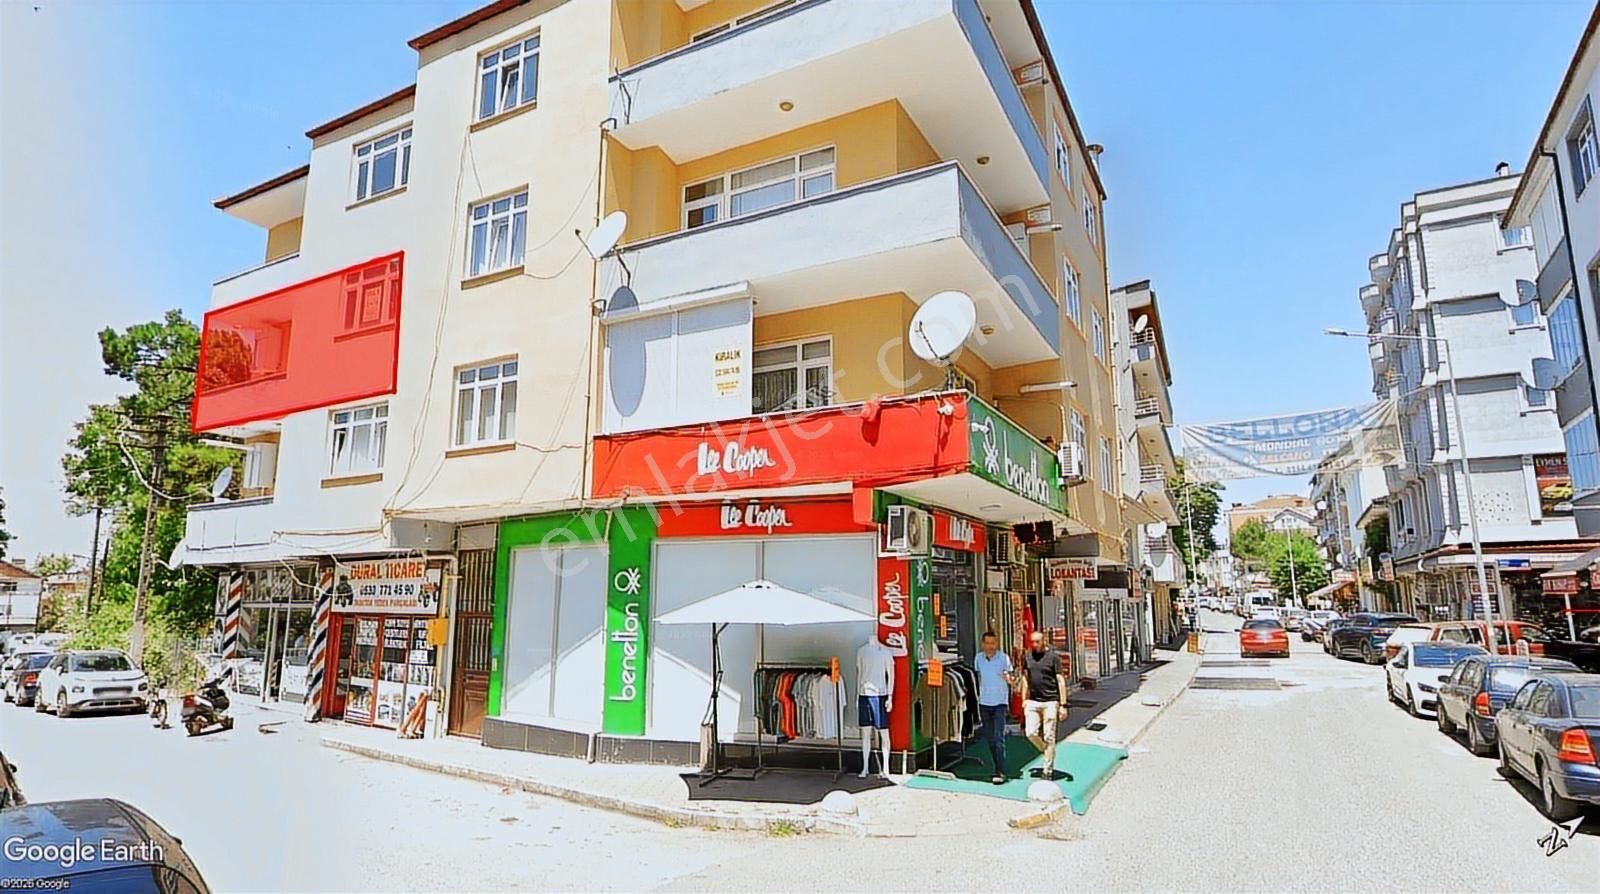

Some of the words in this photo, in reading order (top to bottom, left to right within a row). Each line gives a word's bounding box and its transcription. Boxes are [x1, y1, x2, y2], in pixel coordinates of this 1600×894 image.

[723, 441, 777, 478] Cooper
[745, 499, 793, 535] Cooper
[380, 583, 392, 596] 771
[880, 572, 909, 628] Cooper
[609, 602, 639, 702] benetton
